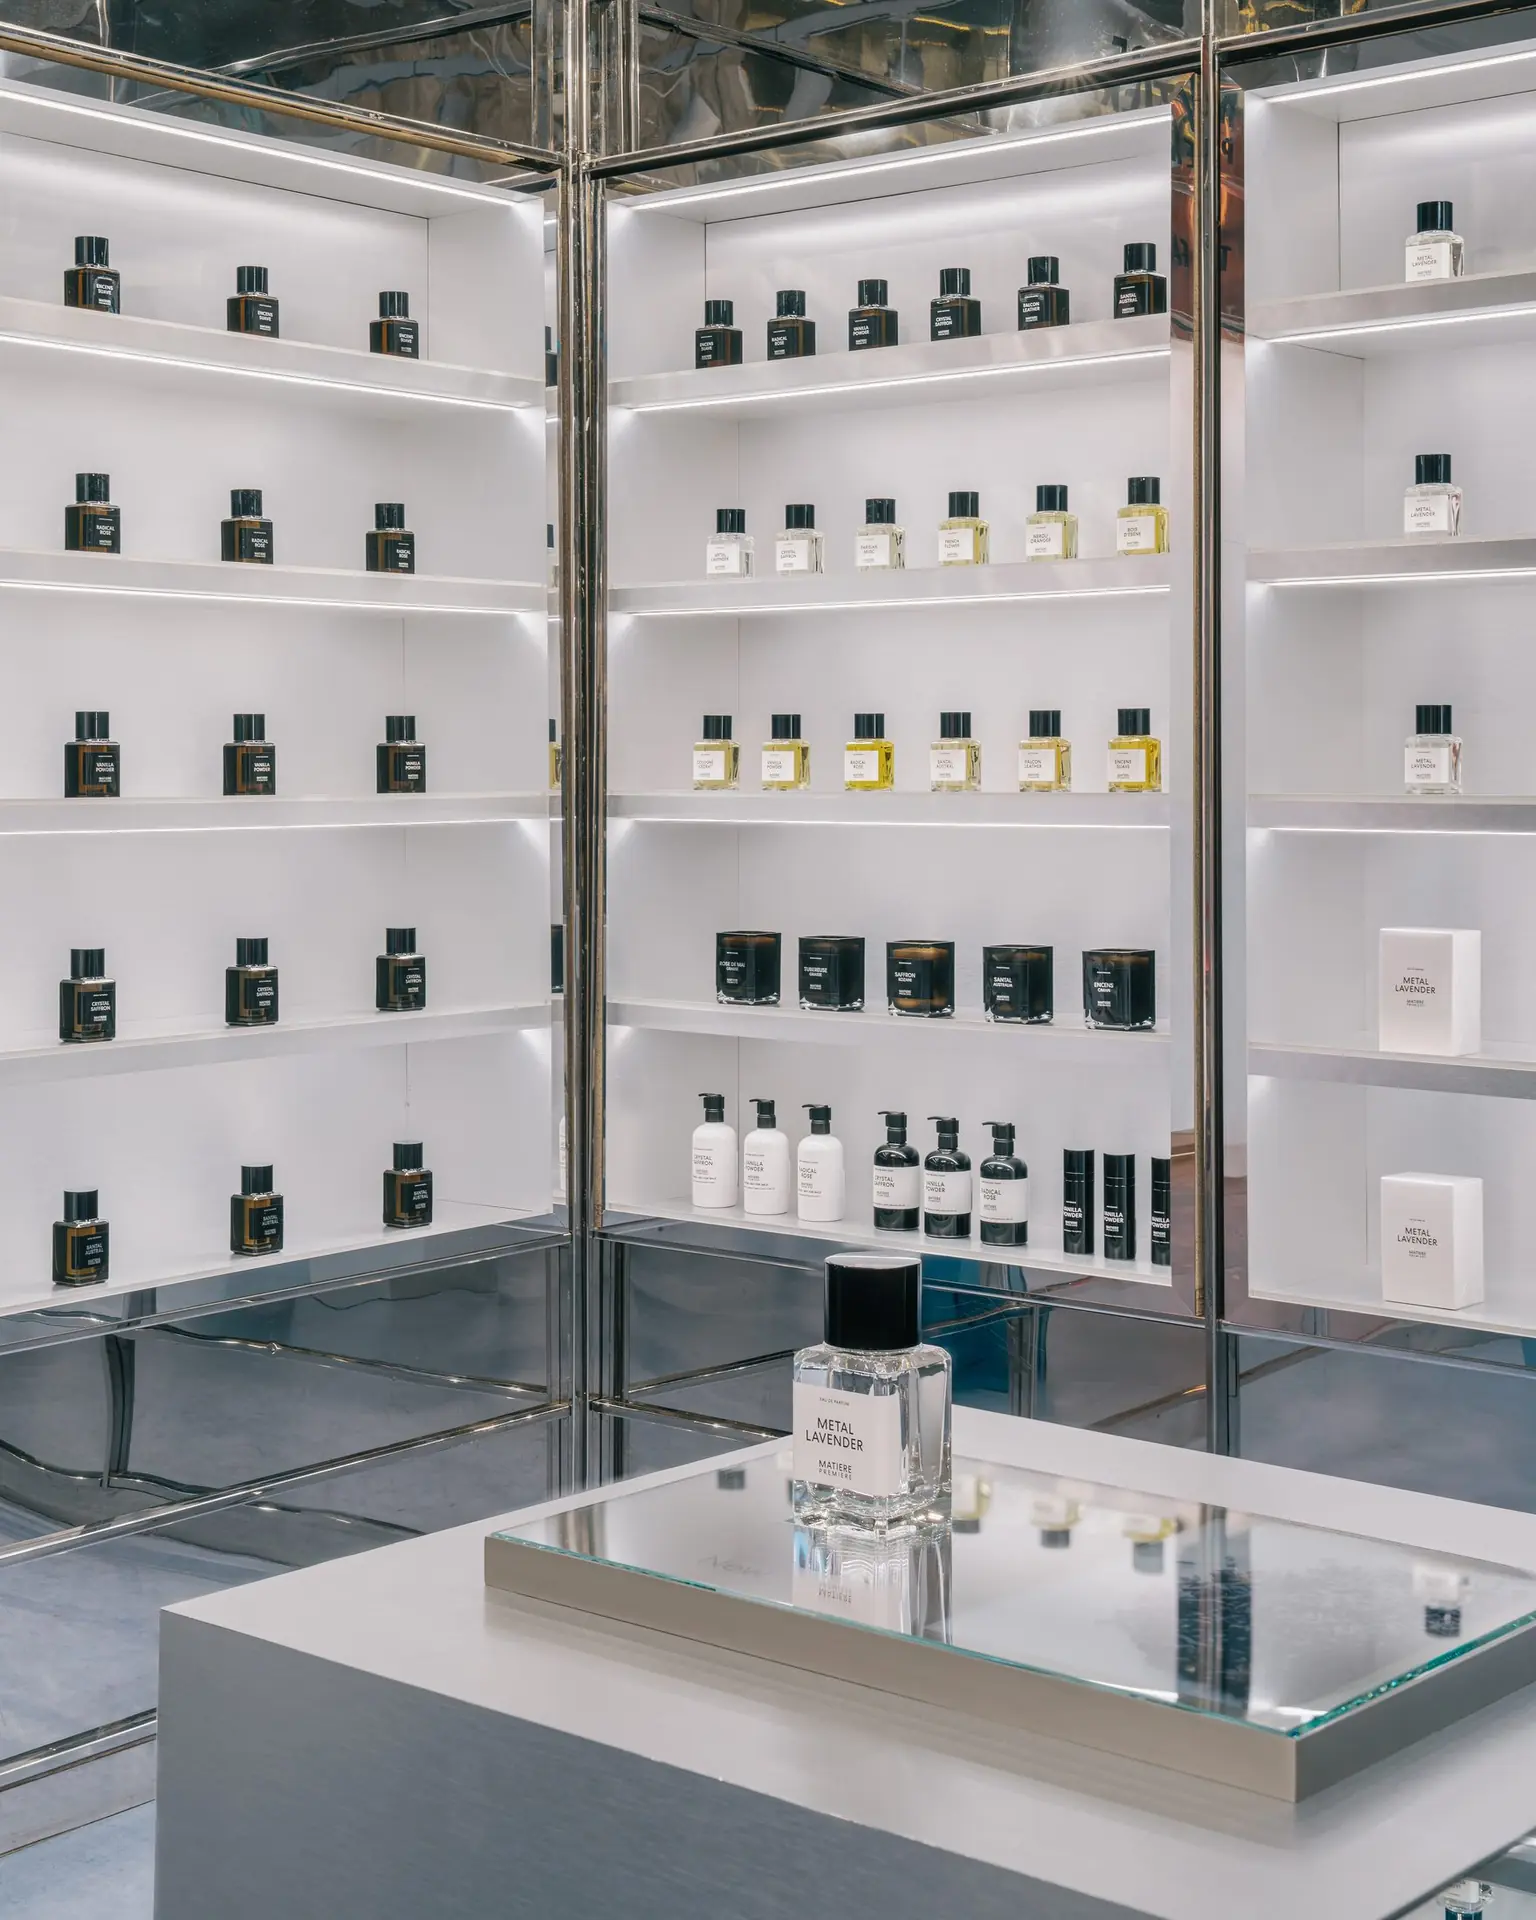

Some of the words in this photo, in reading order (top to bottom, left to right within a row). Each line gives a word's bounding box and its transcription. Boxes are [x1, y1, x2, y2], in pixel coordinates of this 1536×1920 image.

[1403, 976, 1429, 986] METAL
[1395, 984, 1436, 994] LAVENDER
[1405, 1227, 1430, 1237] METAL
[1397, 1234, 1438, 1246] LAVENDER
[817, 1417, 854, 1435] METAL
[805, 1429, 864, 1451] LAVENDER
[818, 1460, 852, 1473] MATIERE
[818, 1468, 852, 1480] PREMIERE
